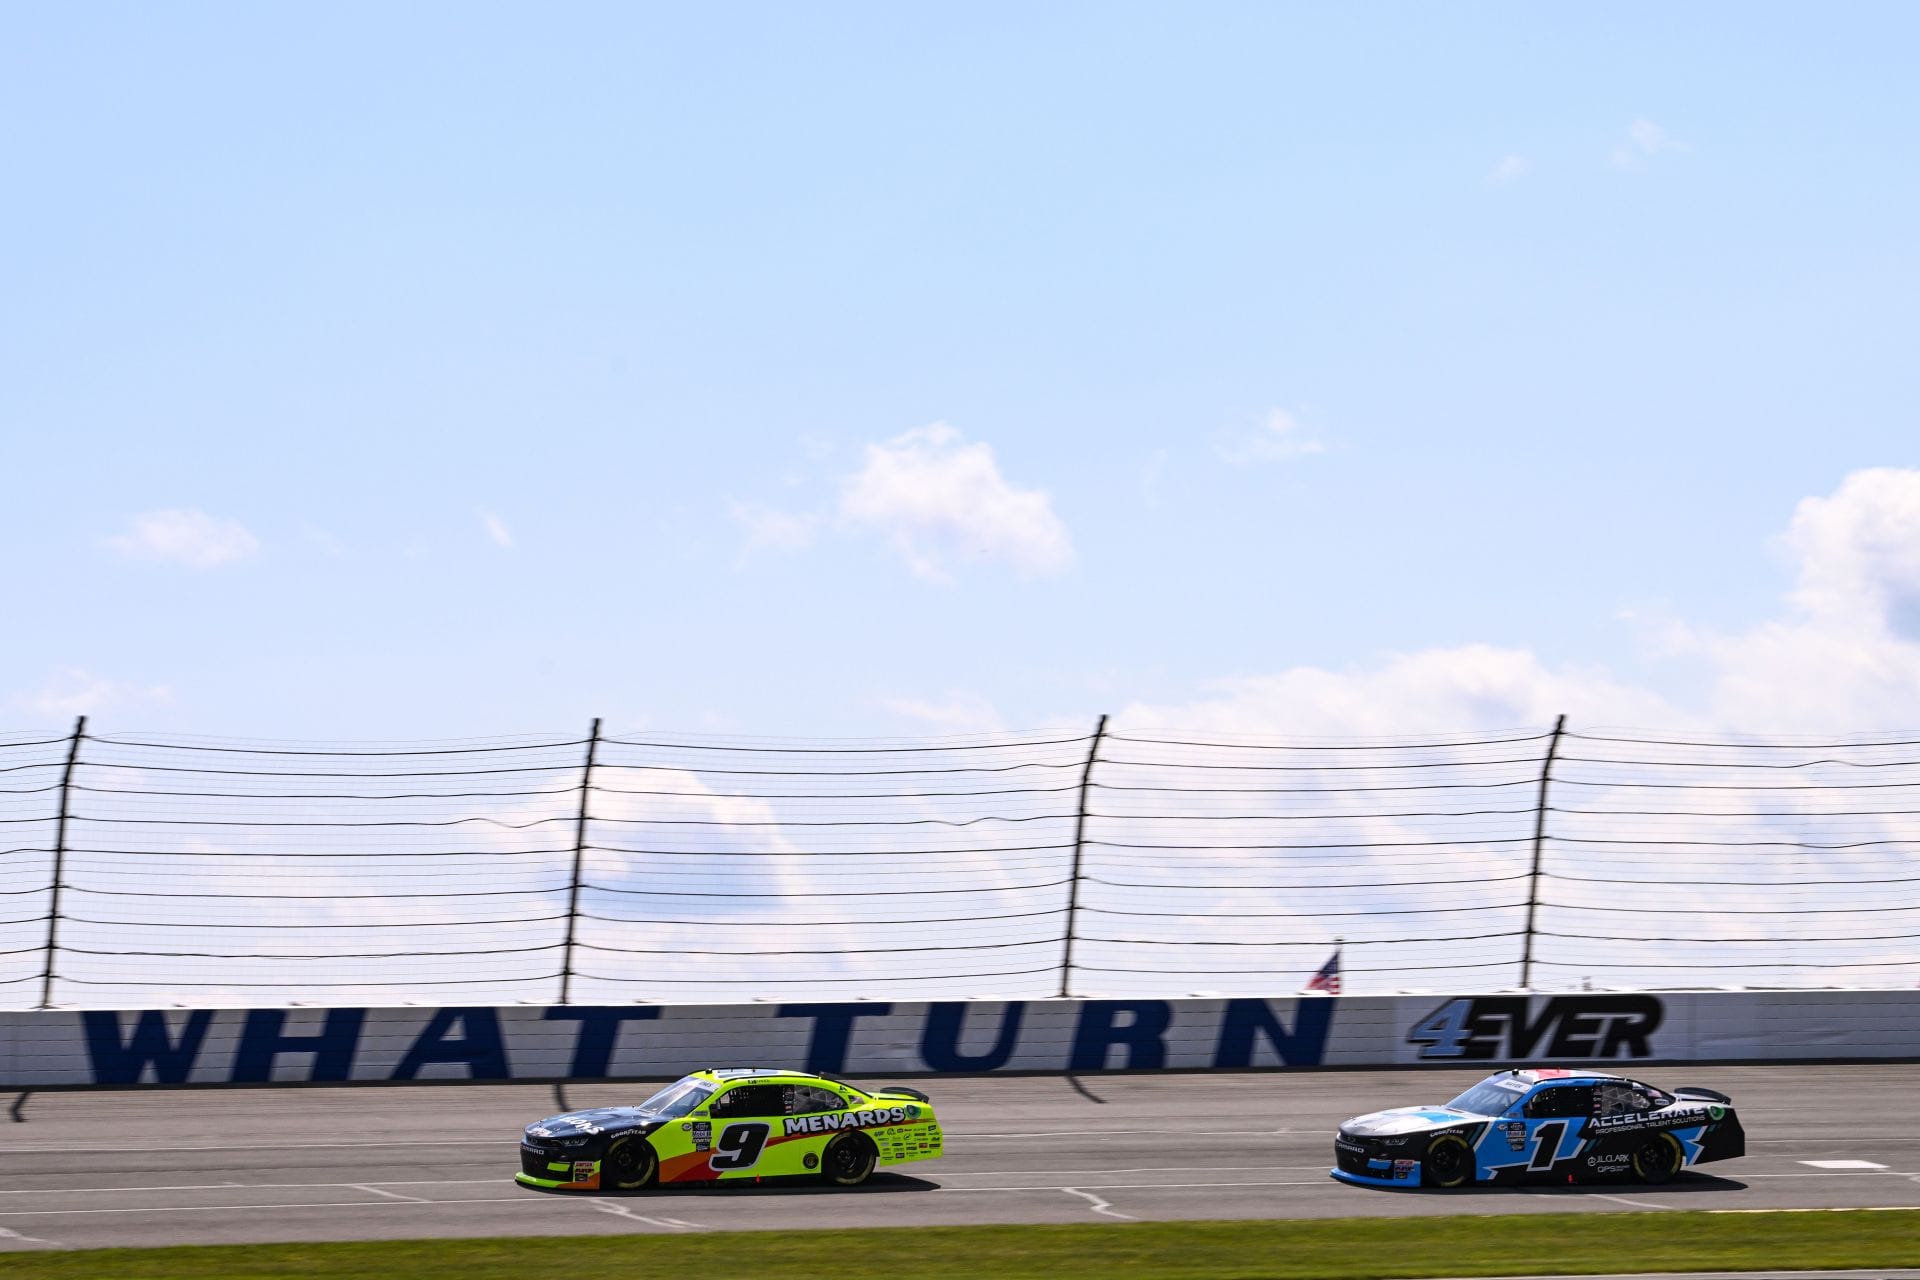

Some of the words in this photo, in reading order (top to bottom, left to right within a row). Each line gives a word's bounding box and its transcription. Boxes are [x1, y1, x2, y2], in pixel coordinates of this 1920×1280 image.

[80, 1005, 661, 1085] WHAT
[774, 997, 1337, 1074] TURN
[1406, 994, 1665, 1060] 4EVER
[784, 1106, 905, 1136] MENARDS
[1588, 1107, 1705, 1128] ACCELERATE
[1595, 1123, 1645, 1134] PROFESSIONAL
[1646, 1119, 1672, 1128] TALENT
[1671, 1114, 1706, 1125] SOLUTIONS
[610, 1128, 647, 1139] GOODYEAR
[709, 1121, 771, 1171] 9
[1429, 1128, 1464, 1138] GOODYEAR
[1526, 1120, 1569, 1172] 1
